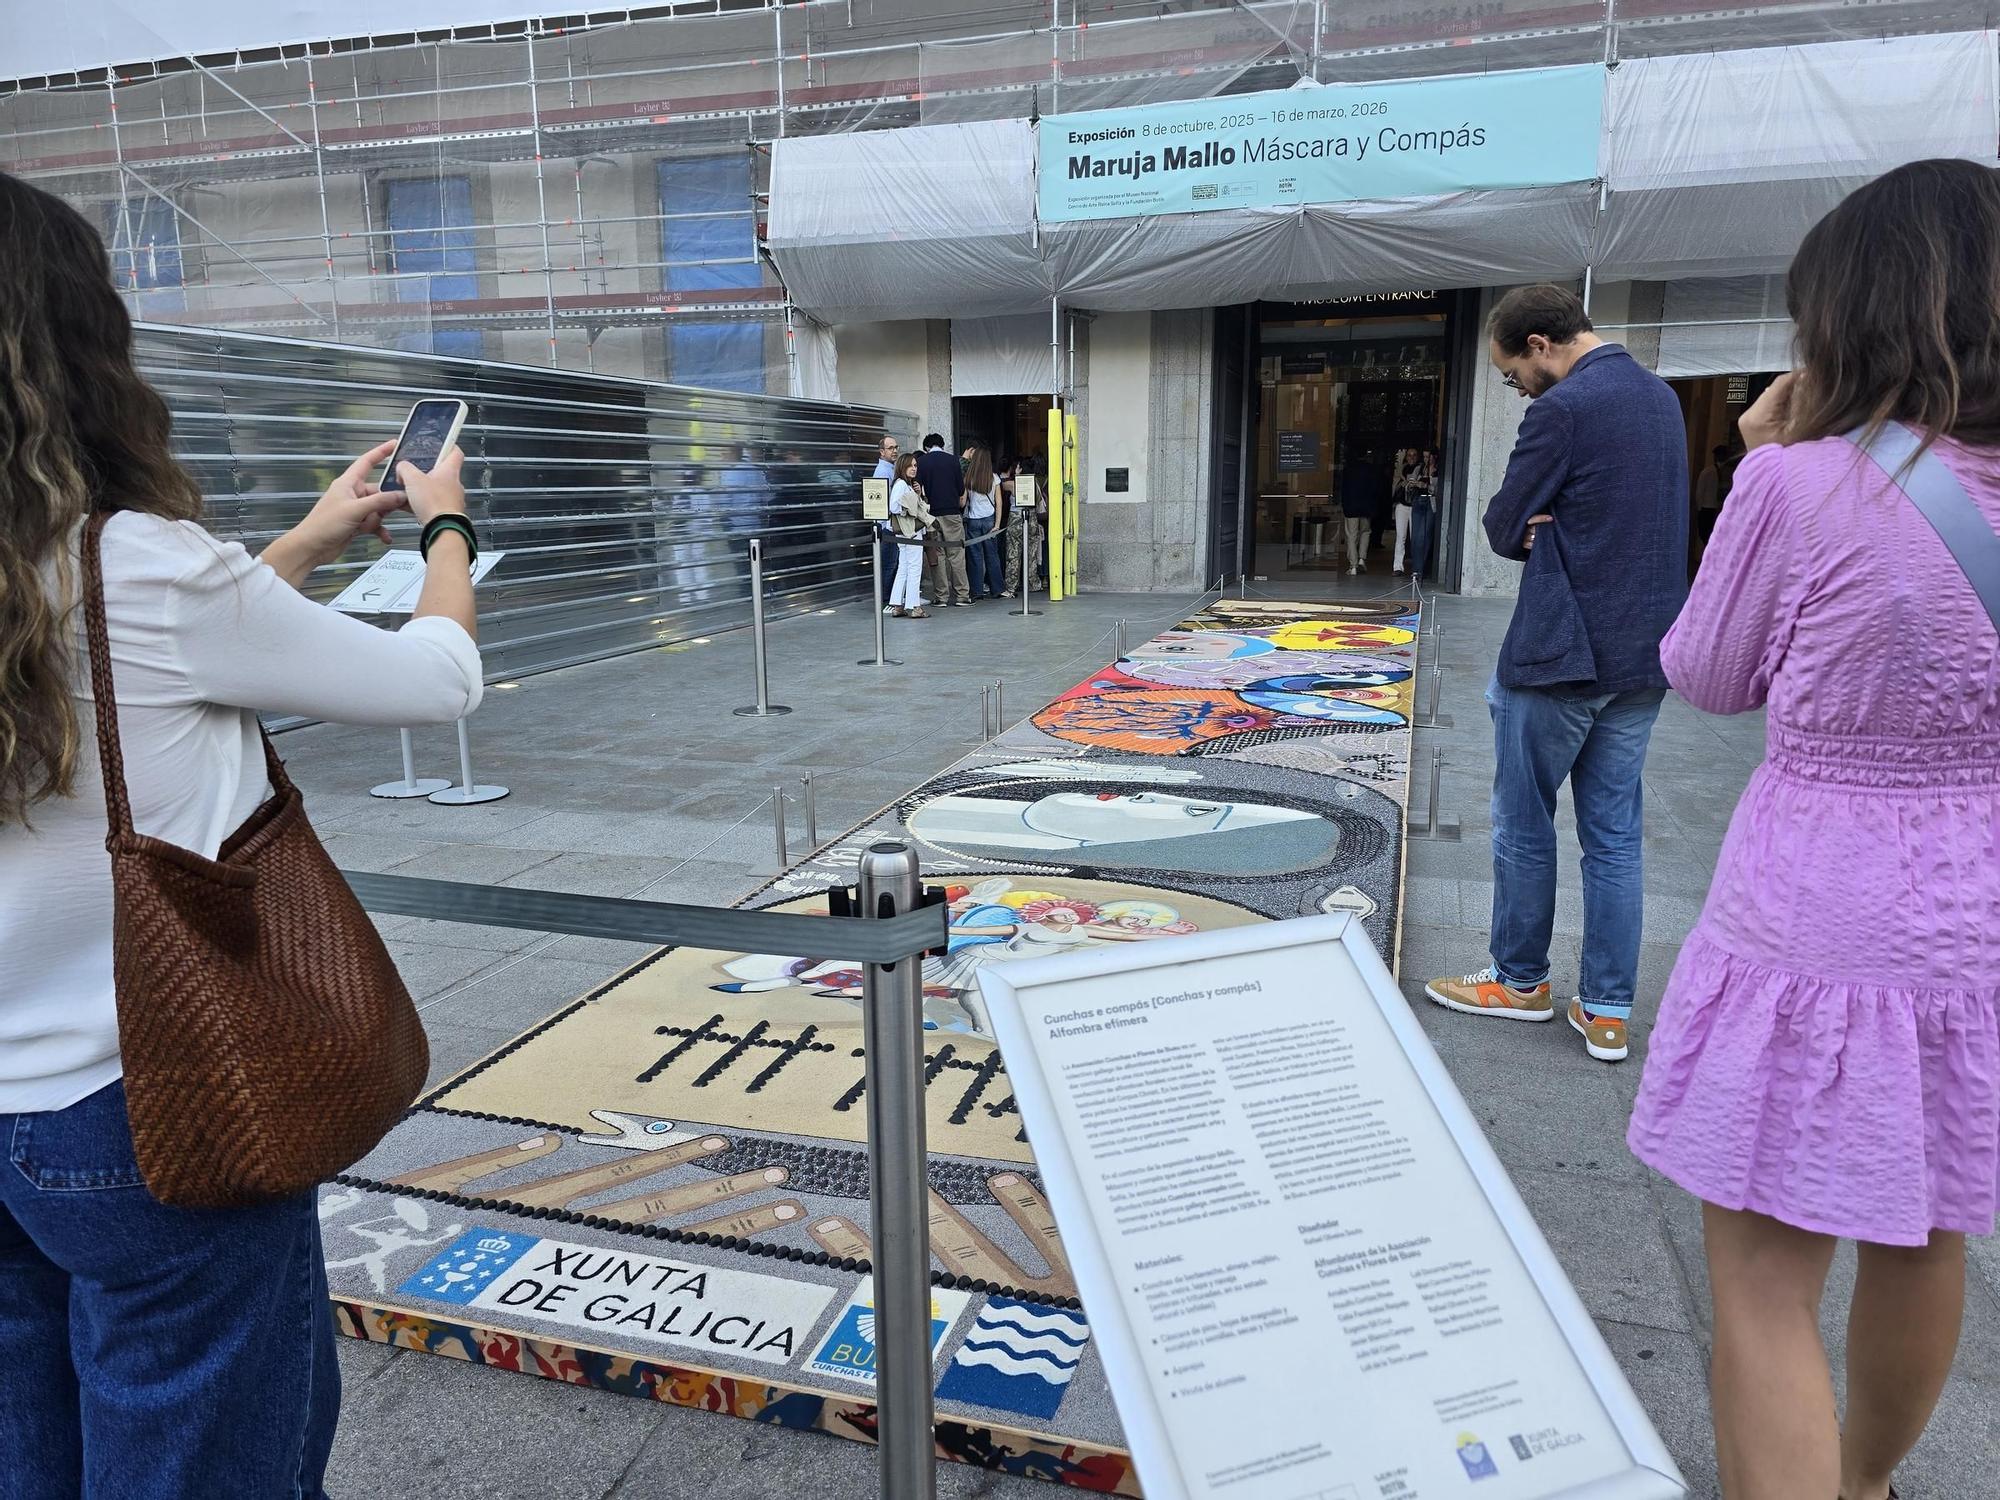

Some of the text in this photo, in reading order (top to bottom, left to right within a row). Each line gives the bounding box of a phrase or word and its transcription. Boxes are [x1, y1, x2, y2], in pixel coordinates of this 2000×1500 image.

[634, 103, 660, 113] Layher
[1068, 127, 1135, 145] Exposición
[1142, 125, 1151, 137] 8
[1153, 123, 1167, 136] de
[1170, 120, 1216, 134] octubre,
[1220, 113, 1254, 129] 2025
[1272, 110, 1286, 123] 16
[1289, 108, 1304, 122] de
[1307, 107, 1347, 121] marzo,
[1351, 101, 1388, 117] 2026
[1068, 122, 1487, 180] Maruja Mallo Máscara y Compás
[646, 293, 671, 303] Layher
[1044, 981, 1263, 1026] Cunchas e compás [Conchas y compás]
[1049, 1014, 1149, 1040] Alfombra efímera
[1298, 1220, 1340, 1234] Diseñador
[1135, 1254, 1185, 1271] Materiales:
[1314, 1237, 1433, 1267] Alfombristas de la Asociación
[532, 1248, 708, 1300] XUNTA
[1318, 1265, 1355, 1278] Cunchas
[1361, 1258, 1388, 1269] Flores
[496, 1279, 794, 1357] DE GALICIA
[811, 1362, 862, 1378] CUNCHAS
[831, 1344, 876, 1372] BU
